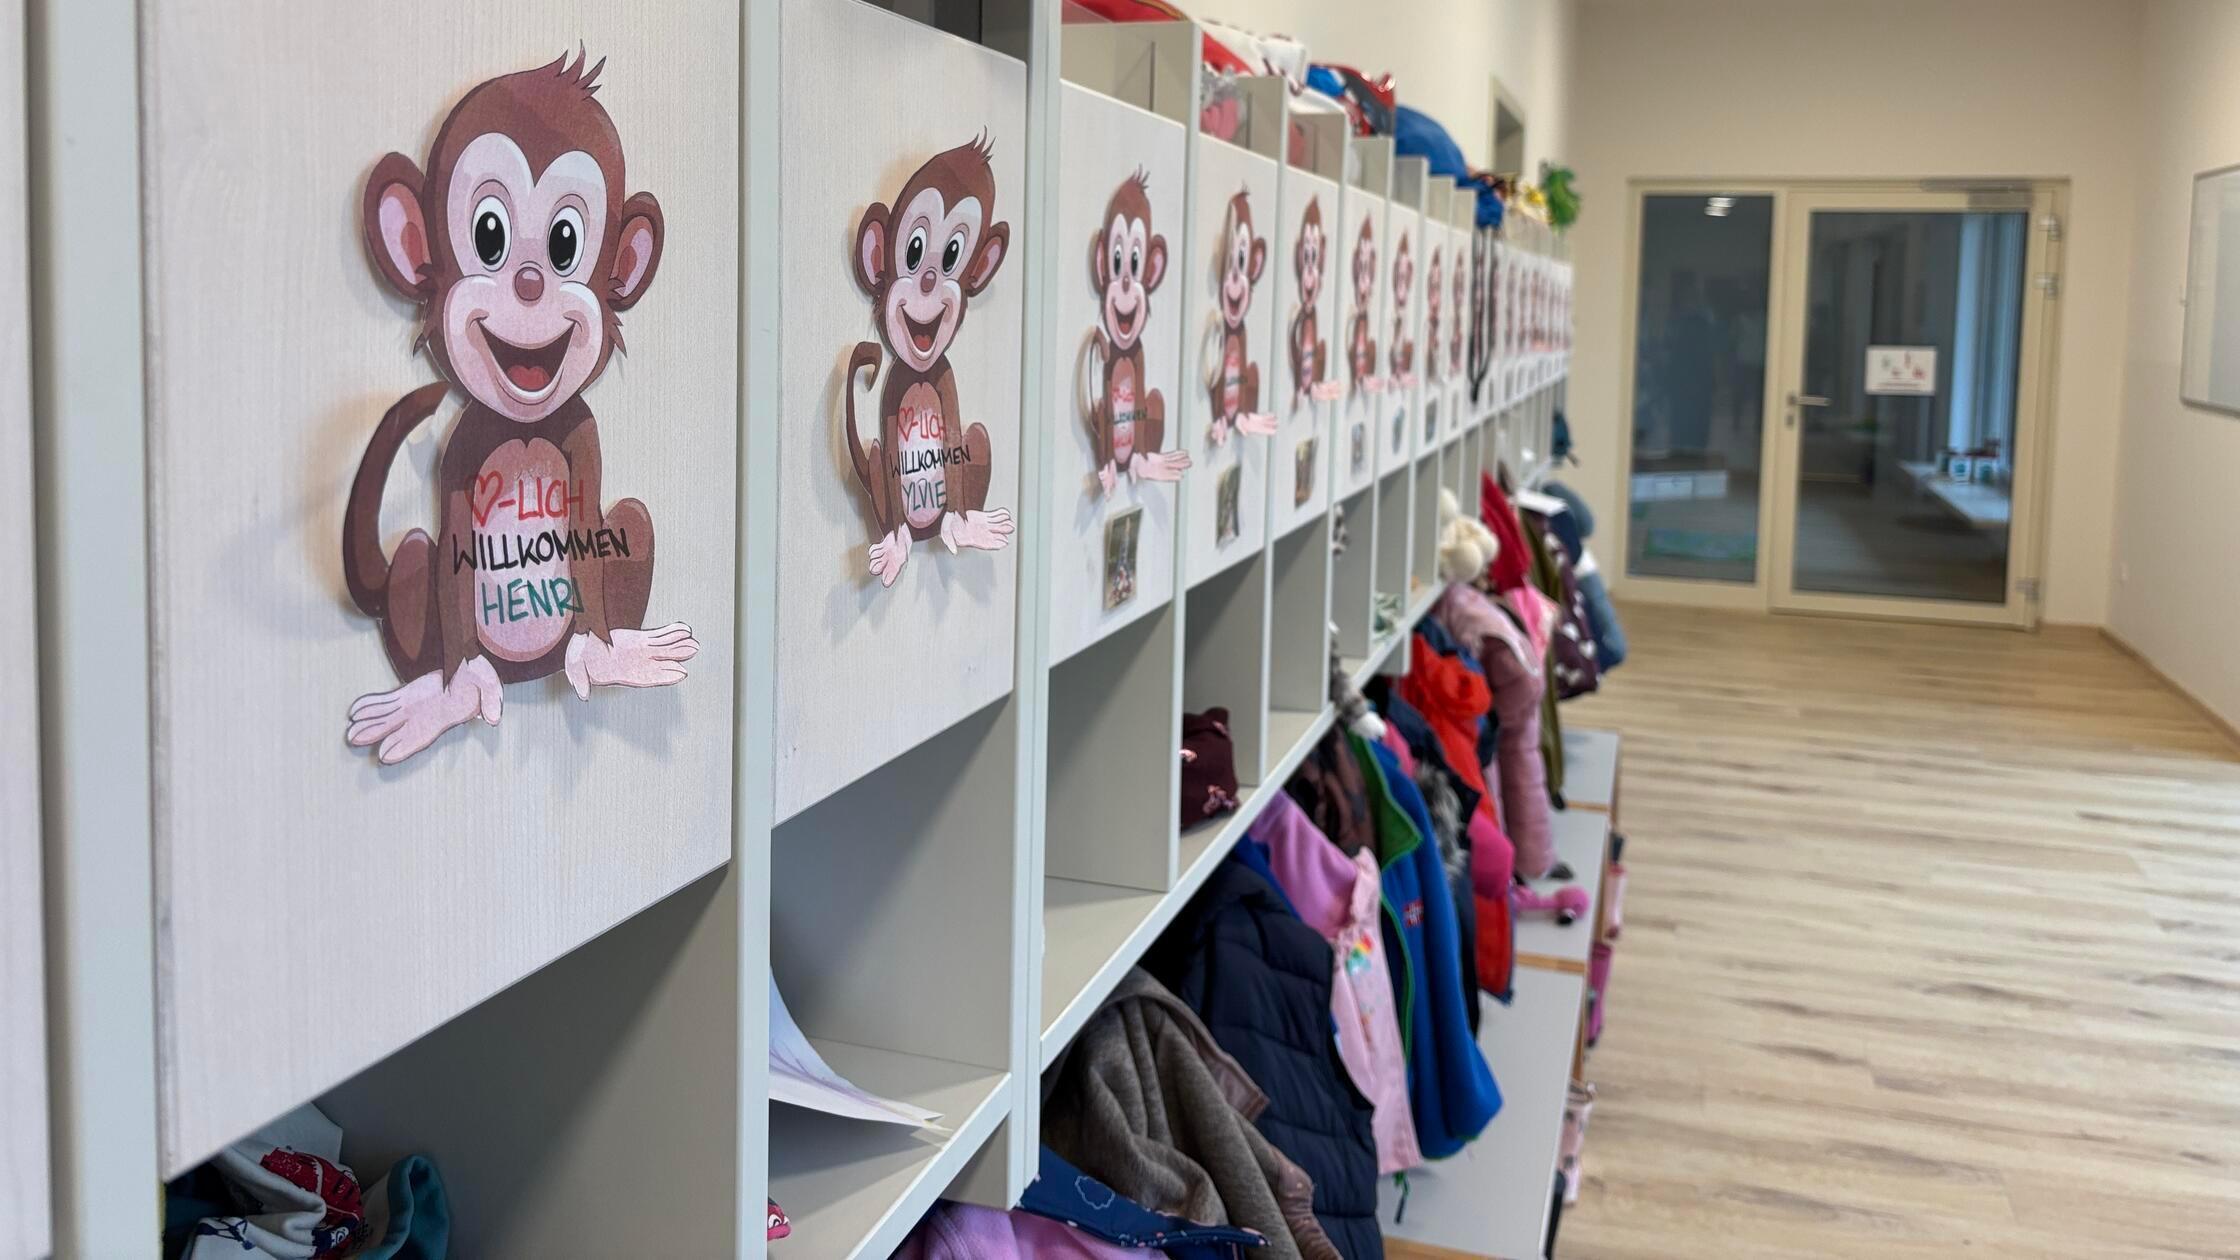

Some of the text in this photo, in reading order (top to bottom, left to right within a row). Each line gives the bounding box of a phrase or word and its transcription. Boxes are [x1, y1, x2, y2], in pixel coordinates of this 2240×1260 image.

[889, 445, 971, 478] WILLKOMMEN
[901, 478, 947, 515] YLVIE
[453, 528, 631, 574] WILLKOMMEN
[481, 577, 584, 626] HENRI
